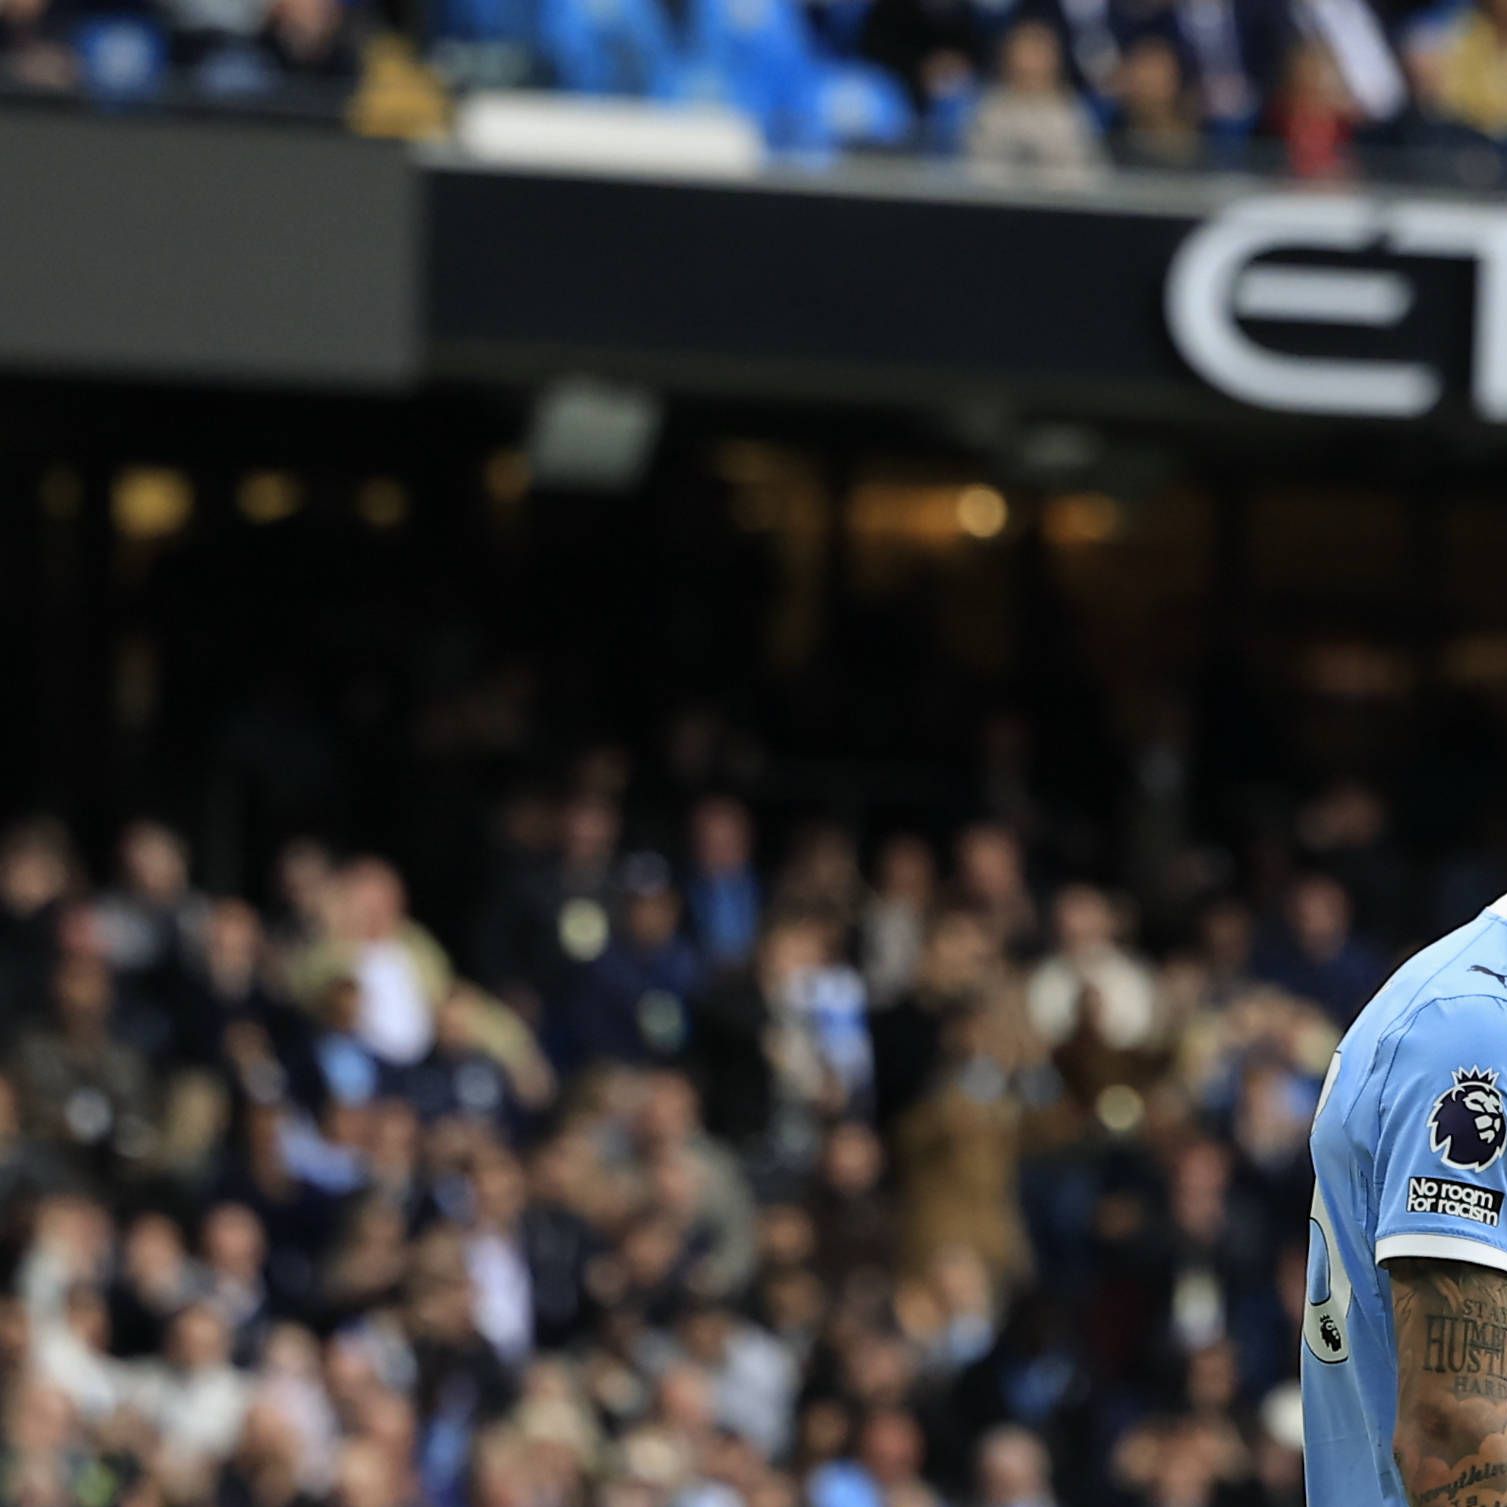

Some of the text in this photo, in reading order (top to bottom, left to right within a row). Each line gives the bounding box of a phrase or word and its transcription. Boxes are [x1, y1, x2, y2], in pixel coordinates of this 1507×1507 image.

[1410, 1178, 1493, 1208] No room
[1408, 1195, 1498, 1226] for racism
